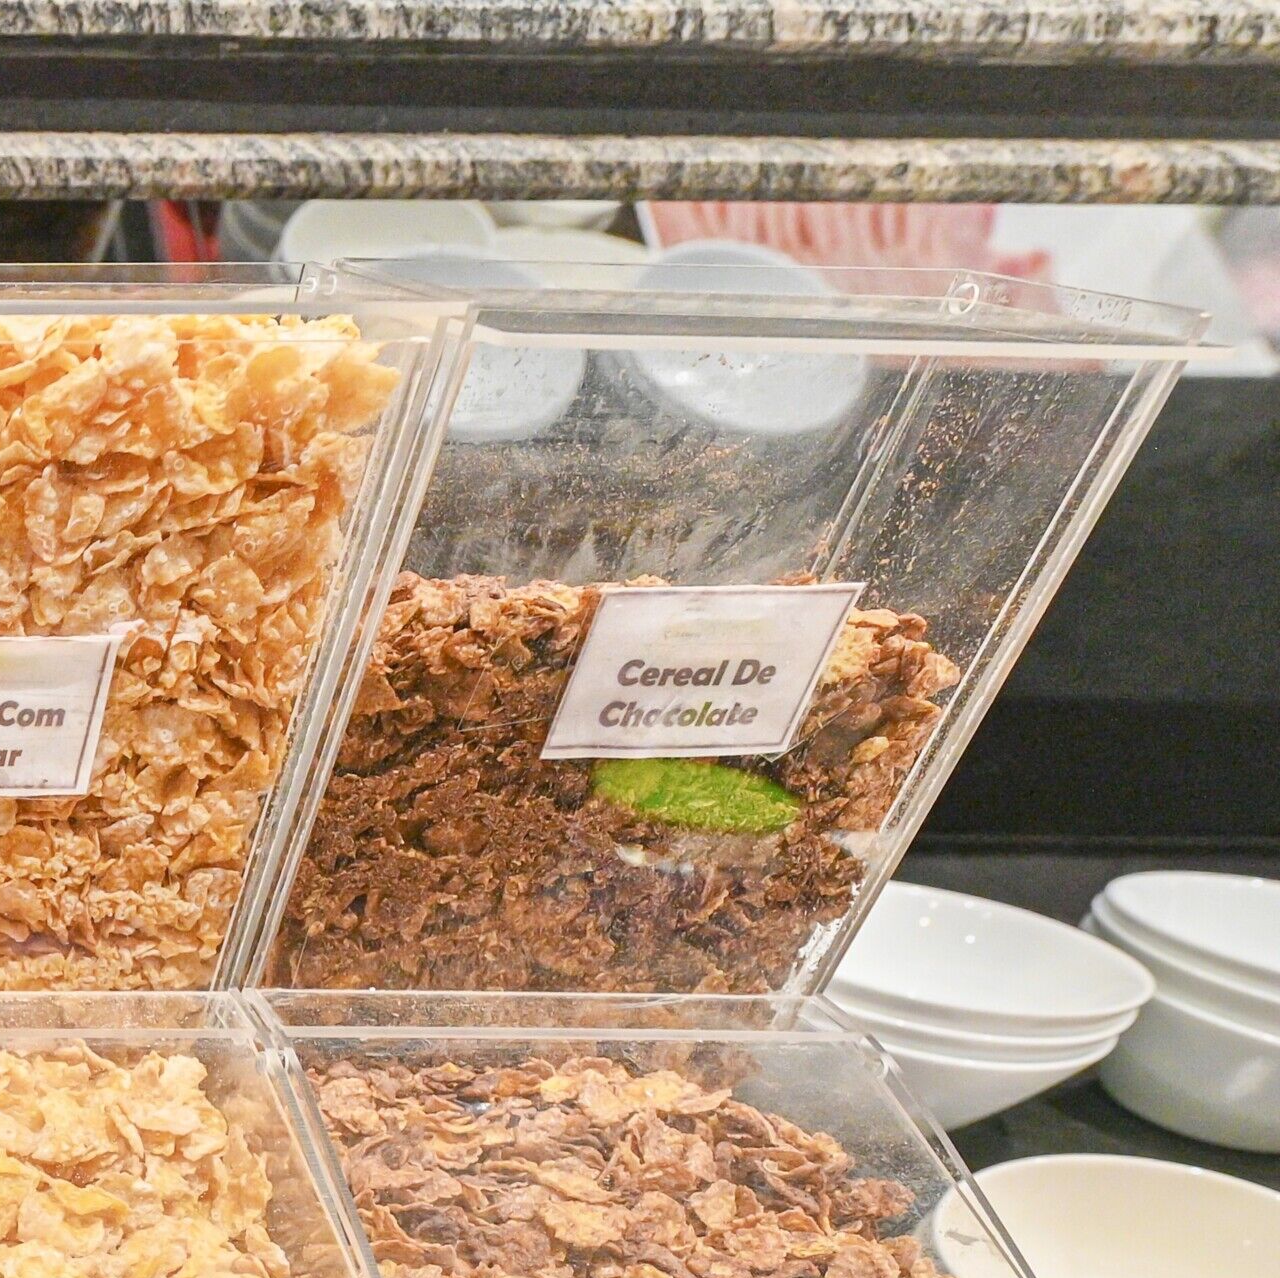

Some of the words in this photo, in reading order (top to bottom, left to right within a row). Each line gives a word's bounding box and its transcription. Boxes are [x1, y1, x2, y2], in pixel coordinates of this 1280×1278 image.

[616, 658, 730, 688] Cereal
[731, 658, 777, 686] De
[598, 700, 759, 728] Chocolate
